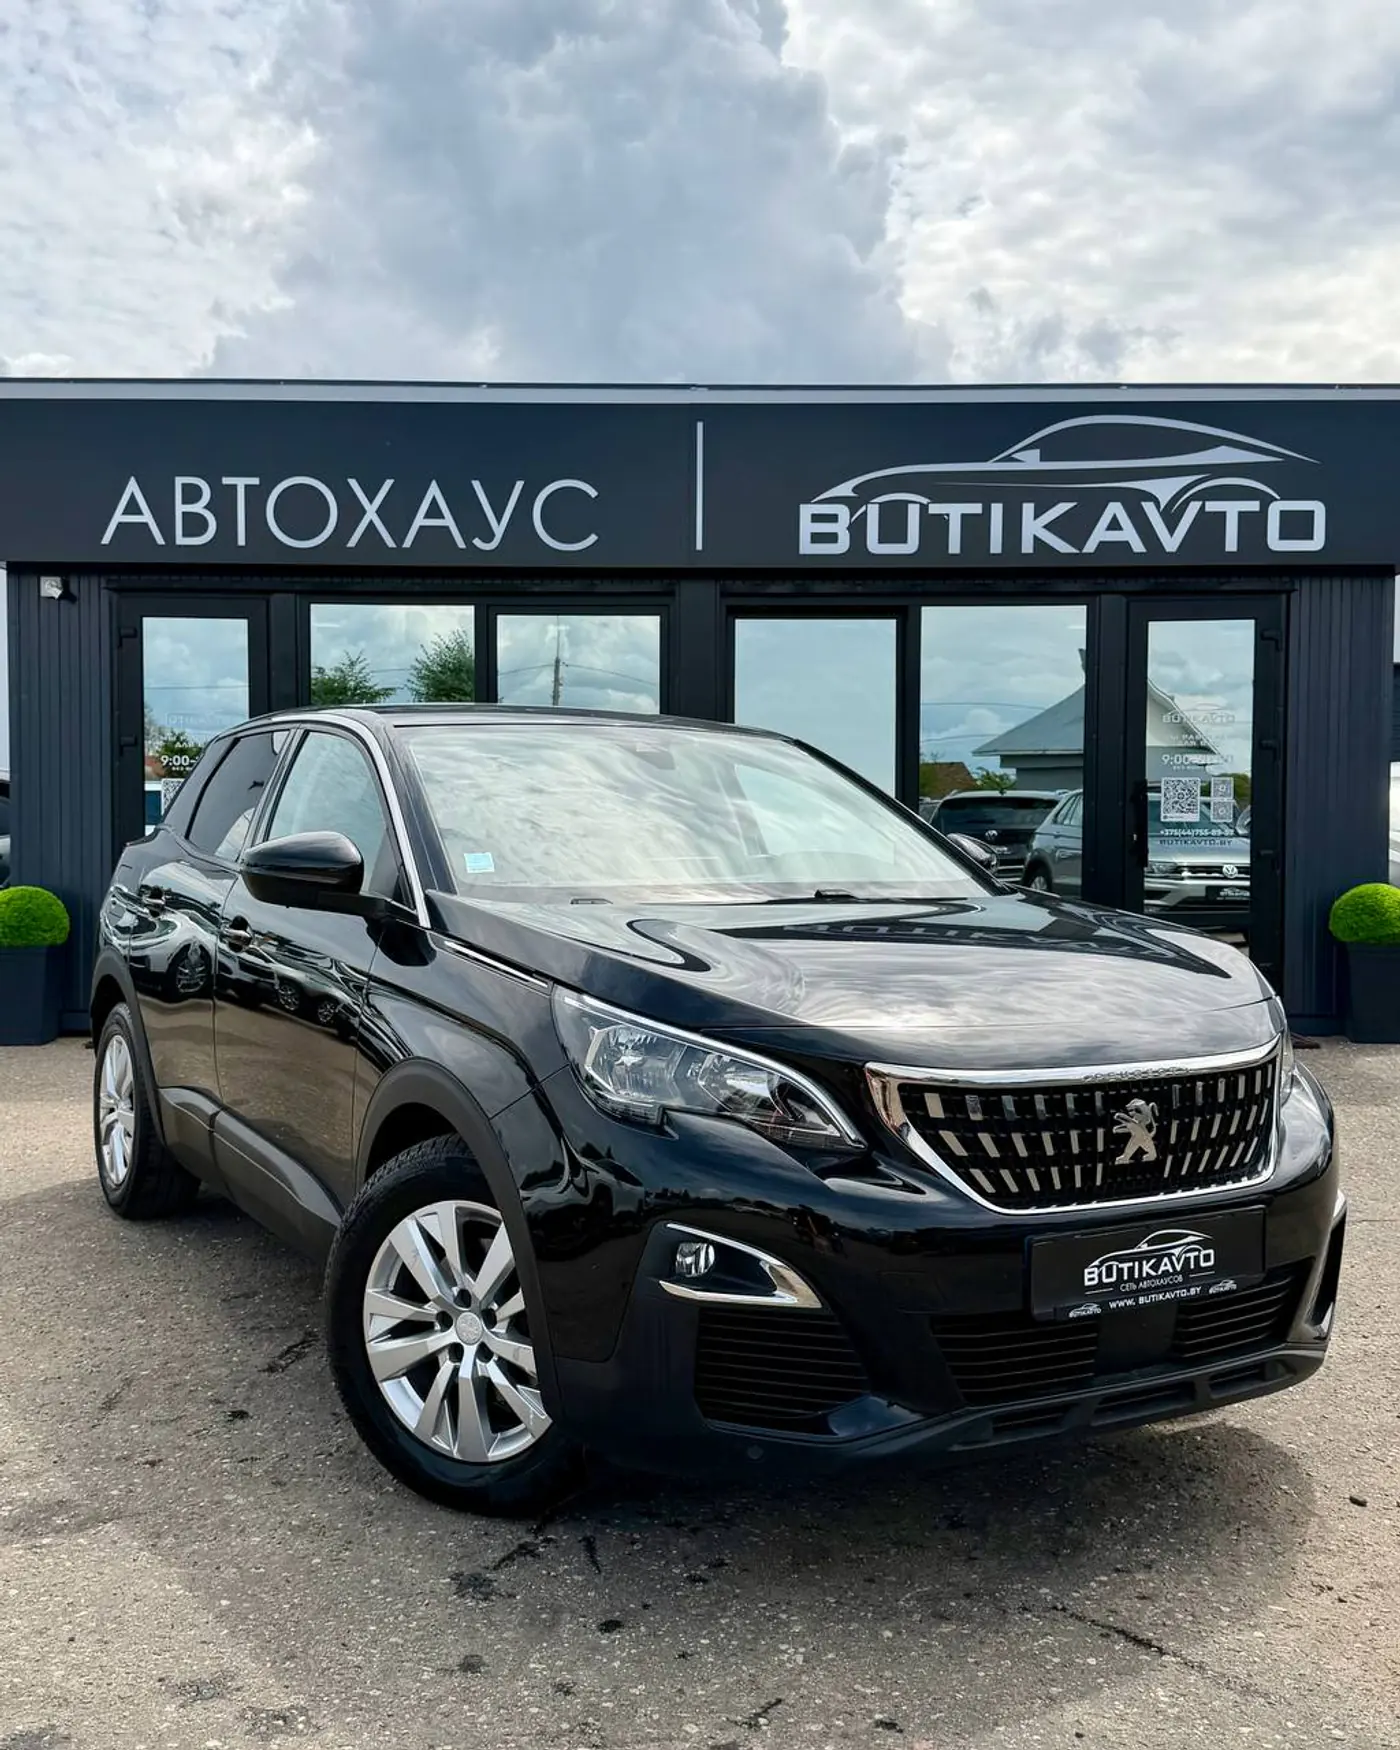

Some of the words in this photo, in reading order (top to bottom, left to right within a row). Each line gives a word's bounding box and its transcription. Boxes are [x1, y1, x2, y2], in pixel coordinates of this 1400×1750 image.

[101, 475, 599, 552] АВТОХАУС
[798, 500, 1326, 556] BUTIKAVTO
[1083, 1248, 1215, 1287] BUTIKAVTO
